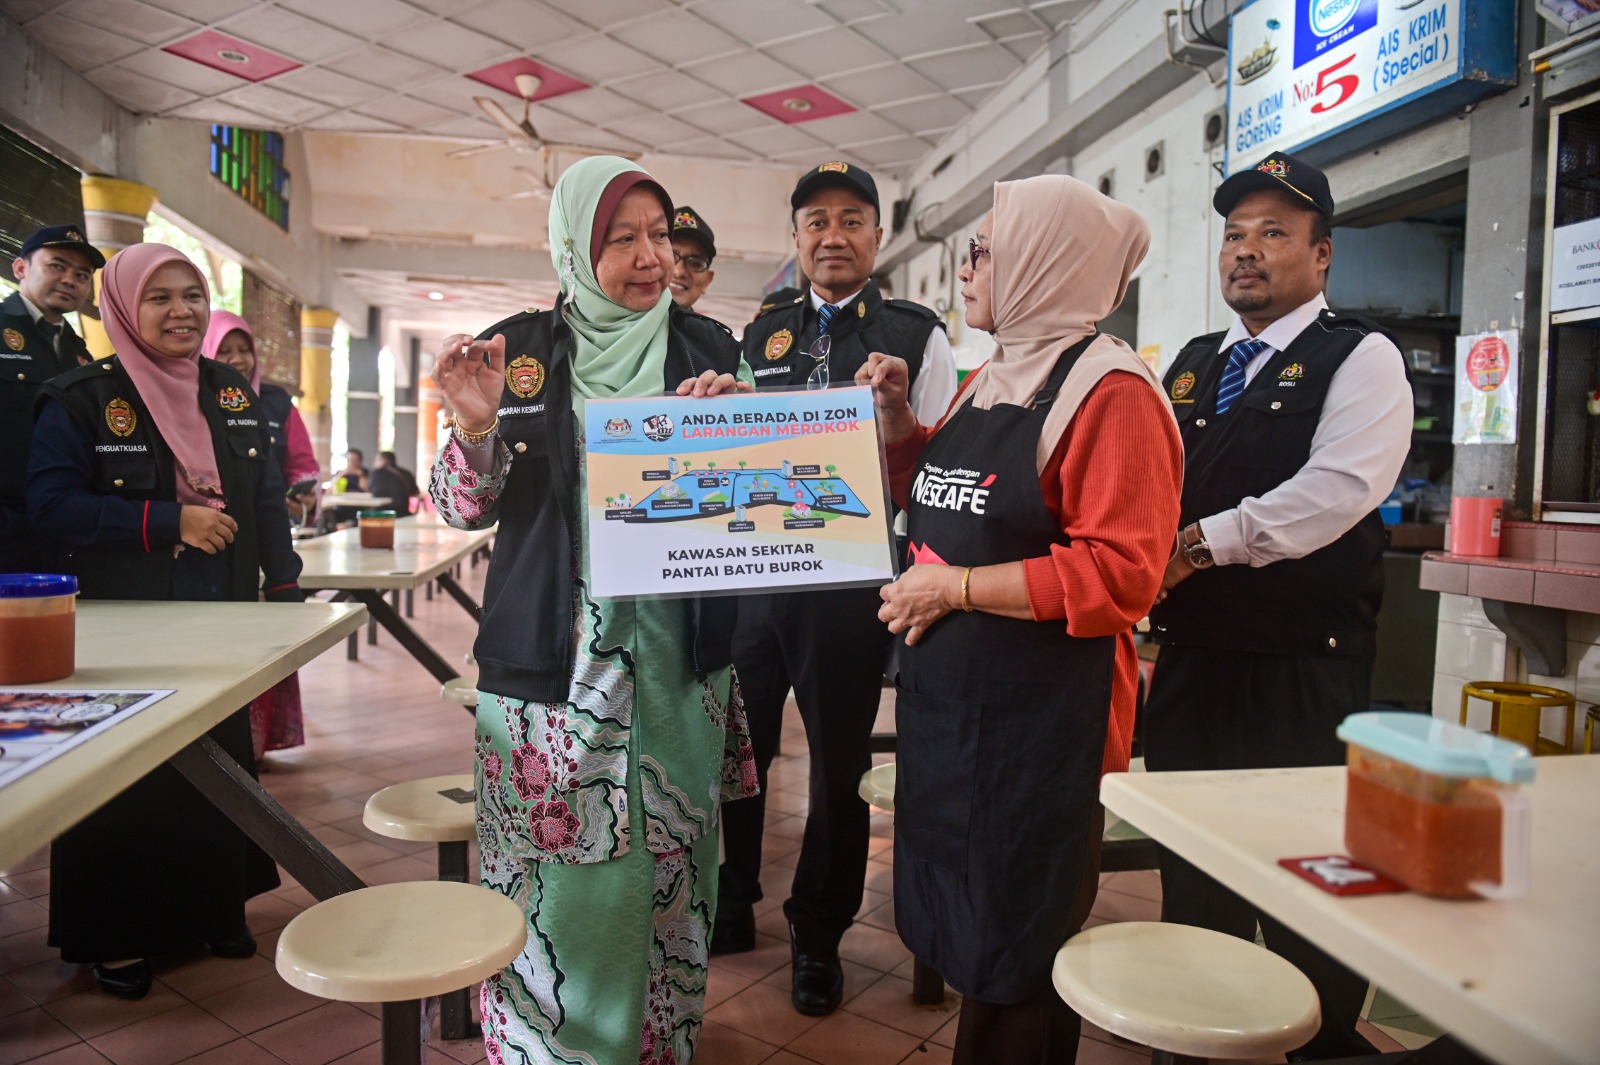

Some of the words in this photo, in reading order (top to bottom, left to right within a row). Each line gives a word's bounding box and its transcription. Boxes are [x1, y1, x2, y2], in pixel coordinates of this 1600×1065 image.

[1316, 39, 1328, 51] ICE
[1328, 24, 1355, 43] CREAM
[1377, 29, 1399, 60] AIS
[1409, 3, 1446, 45] KRIM
[1310, 53, 1359, 114] 5
[1236, 106, 1252, 131] AIS
[1258, 90, 1283, 120] KRIM
[1236, 115, 1281, 152] GORENG
[753, 366, 791, 377] PENGUATKUASA
[681, 414, 729, 425] ANDA
[732, 411, 799, 424] BERADA
[803, 410, 819, 422] DI
[824, 407, 858, 420] ZON
[682, 425, 772, 439] LARANGAN
[776, 420, 860, 436] MEROKOK
[95, 444, 148, 452] PENGUATKUASA
[668, 547, 747, 561] KAWASAN
[751, 543, 815, 557] SEKITAR
[662, 566, 719, 579] PANTAI
[723, 563, 764, 575] BATU
[769, 560, 824, 573] BUROK
